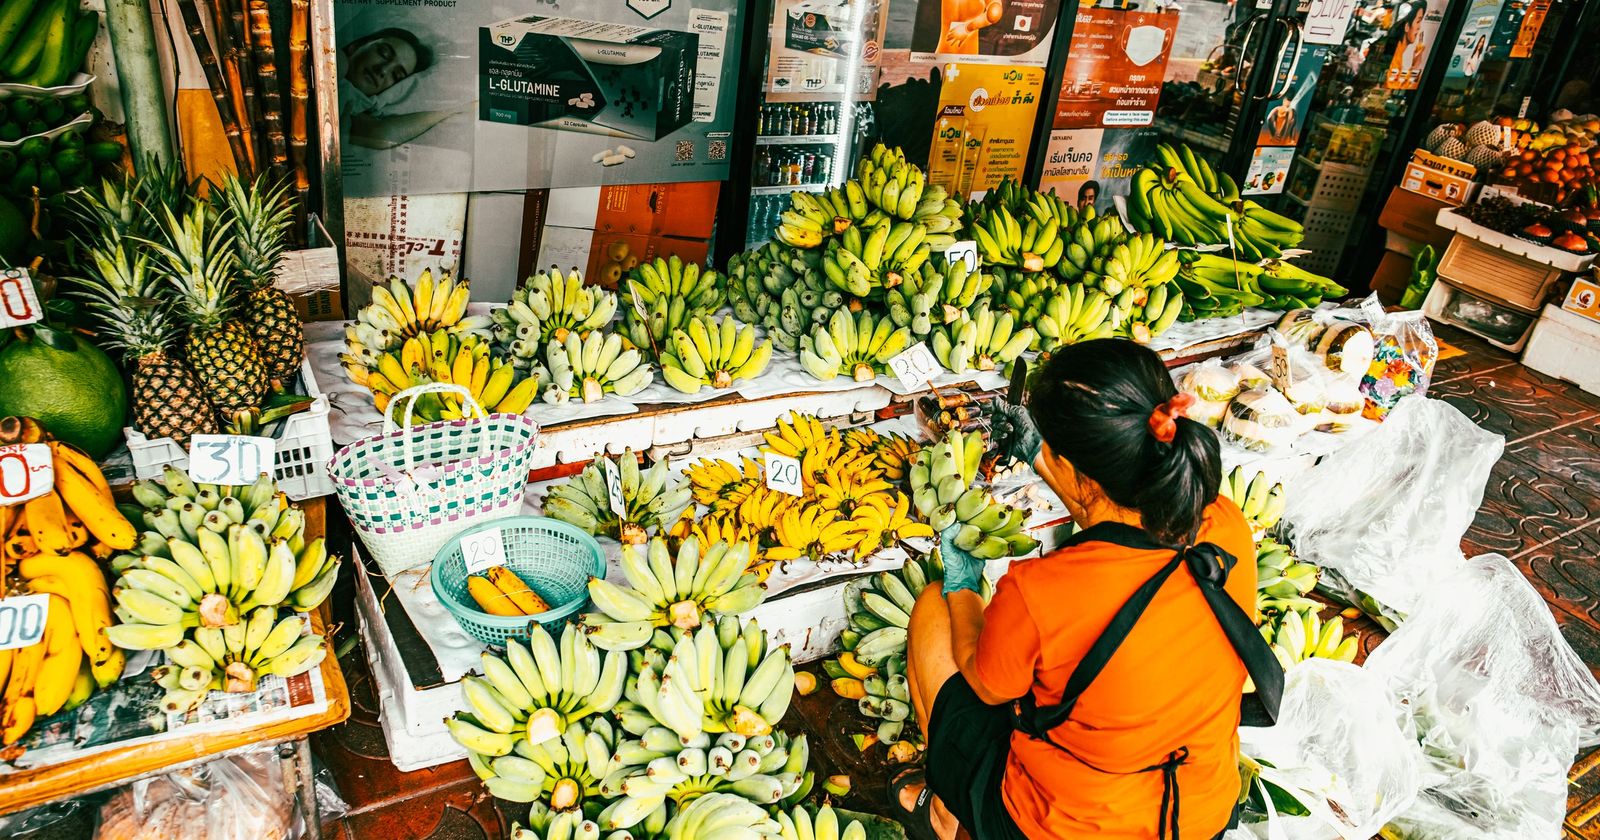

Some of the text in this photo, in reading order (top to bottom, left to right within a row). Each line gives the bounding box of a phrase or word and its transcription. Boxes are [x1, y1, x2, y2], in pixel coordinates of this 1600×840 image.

[500, 35, 513, 44] THP
[598, 49, 626, 57] L-GLUTAMINE
[490, 78, 560, 96] L-GLUTAMINE
[806, 79, 822, 88] THP
[1423, 158, 1447, 172] JUICY
[950, 250, 975, 273] 50
[895, 350, 930, 387] 30
[197, 440, 260, 483] 30
[772, 460, 798, 485] 20
[610, 469, 622, 504] 25
[470, 536, 496, 566] 20
